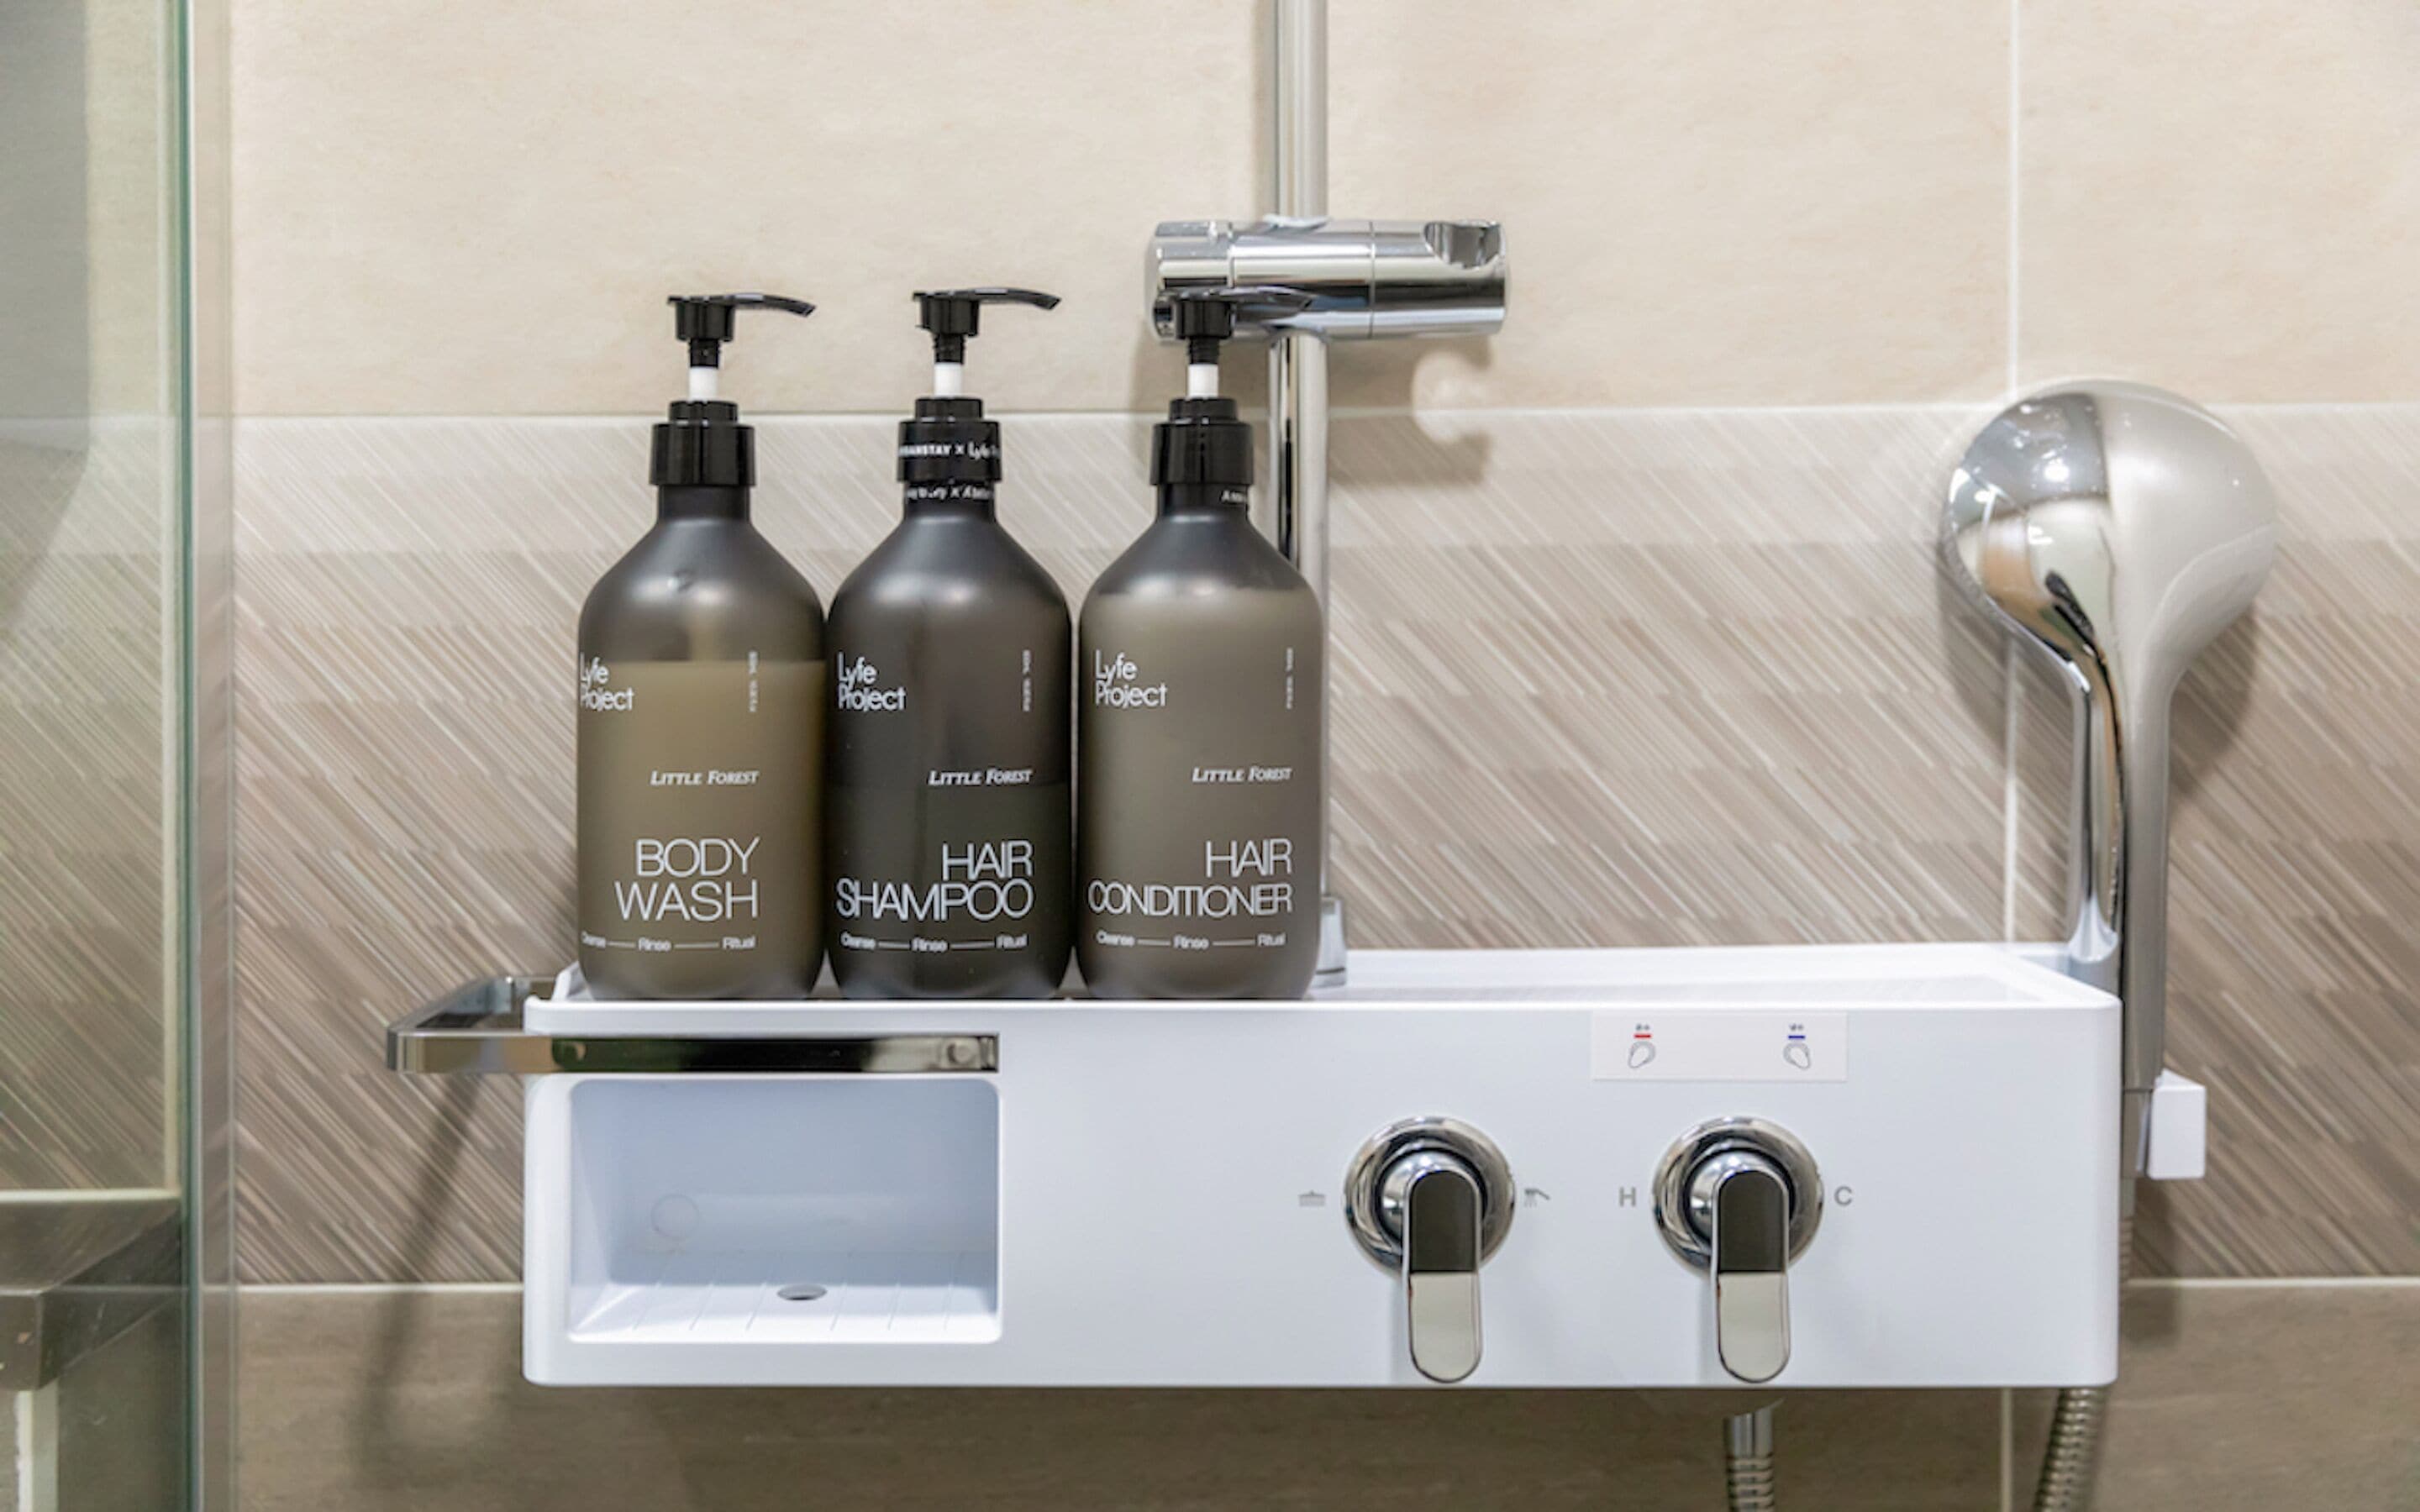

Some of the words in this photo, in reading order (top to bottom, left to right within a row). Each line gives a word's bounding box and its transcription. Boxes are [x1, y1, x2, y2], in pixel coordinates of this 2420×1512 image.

[838, 651, 878, 686] Lyfe
[1095, 649, 1138, 685] Lyfe
[838, 684, 907, 712] Project
[1095, 681, 1168, 709] Project
[650, 770, 703, 786] LITTLE
[707, 769, 760, 785] FOREST
[928, 770, 981, 786] LITTLE
[985, 768, 1033, 785] FOREST
[636, 837, 760, 878] BODY
[942, 840, 1034, 882] HAIR
[1205, 838, 1292, 879] HAIR
[614, 879, 760, 921] WASH
[836, 877, 1034, 921] SHAMPOO
[1089, 879, 1293, 917] CONDITIONER
[1618, 1187, 1637, 1207] H
[1833, 1186, 1853, 1206] C
